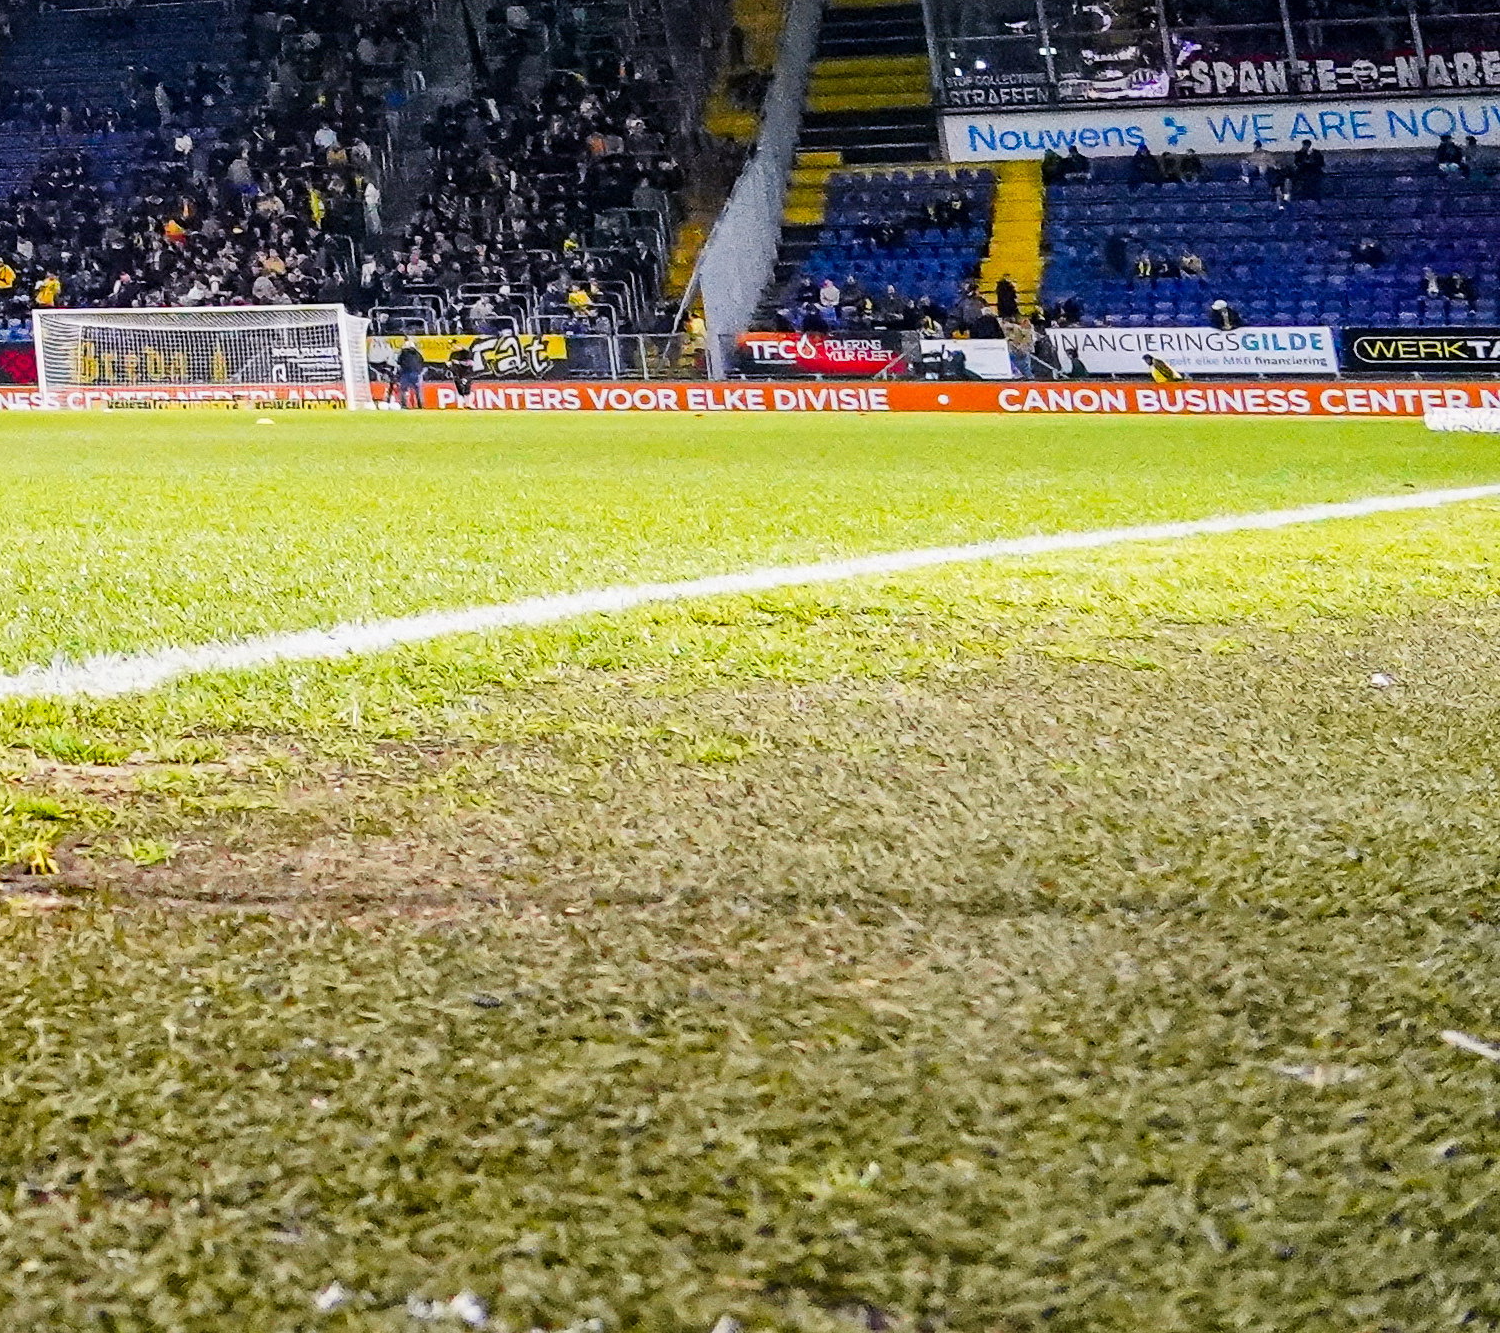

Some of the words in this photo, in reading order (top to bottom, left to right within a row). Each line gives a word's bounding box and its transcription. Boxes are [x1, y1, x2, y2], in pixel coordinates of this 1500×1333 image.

[1206, 112, 1277, 145] WE
[1288, 108, 1373, 141] ARE
[1386, 105, 1500, 138] NOU
[967, 122, 1145, 153] Nouwens
[746, 339, 798, 360] TFC
[824, 349, 857, 362] YOUR
[859, 350, 895, 362] FLEET
[1254, 355, 1328, 368] financiering
[437, 389, 582, 411] PRINTERS
[592, 389, 682, 411] VOOR
[688, 389, 765, 411] ELKE
[773, 388, 891, 412] DIVISIE
[998, 388, 1130, 413] CANON
[1137, 388, 1311, 413] BUSINESS
[1319, 388, 1468, 413] CENTER
